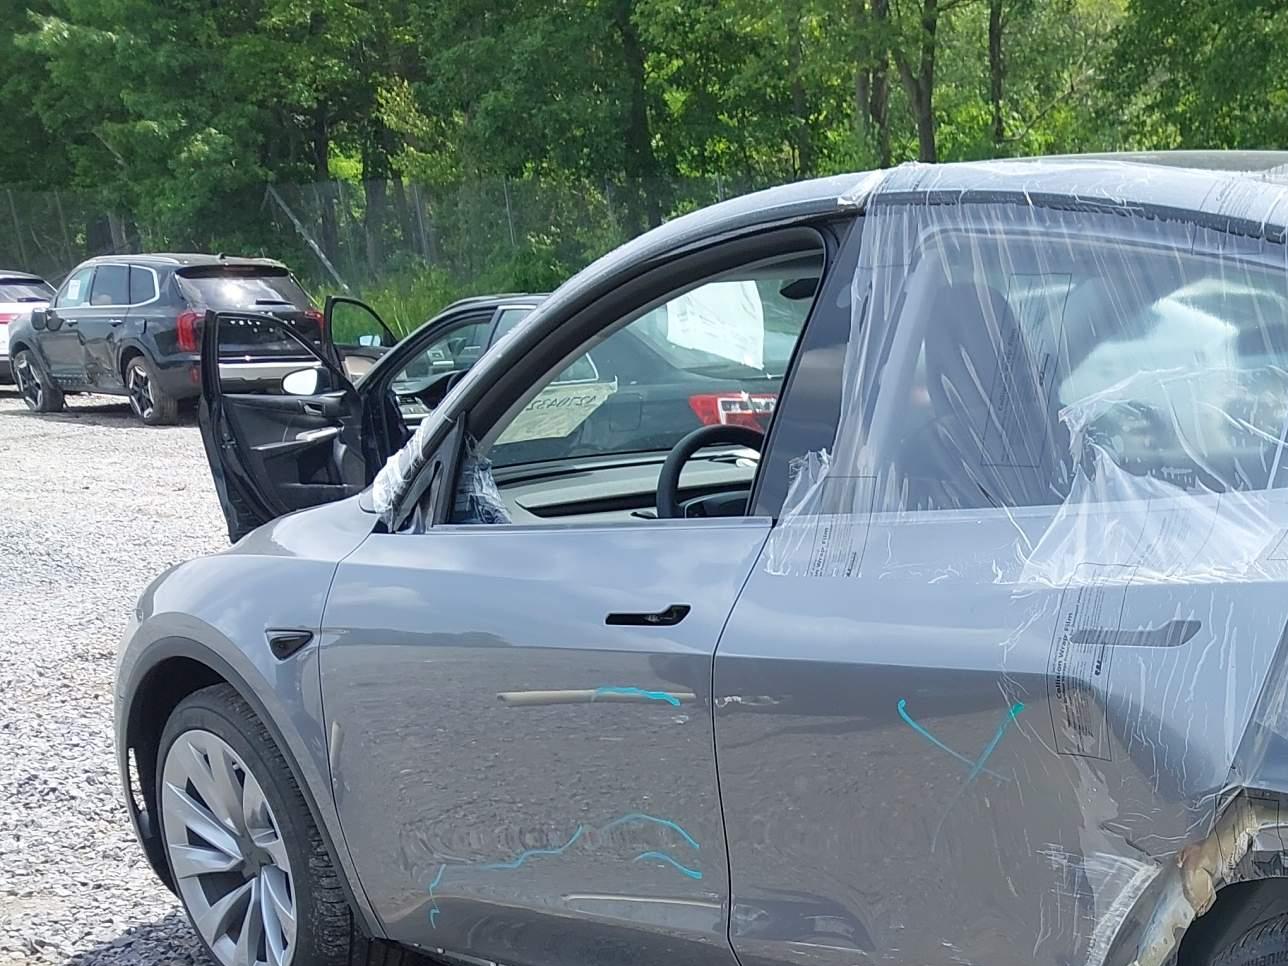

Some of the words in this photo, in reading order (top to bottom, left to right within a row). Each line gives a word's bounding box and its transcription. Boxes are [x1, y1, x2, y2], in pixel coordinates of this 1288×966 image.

[1063, 612, 1073, 633] Film
[1058, 634, 1068, 662] Wrap
[1056, 660, 1064, 699] Collision
